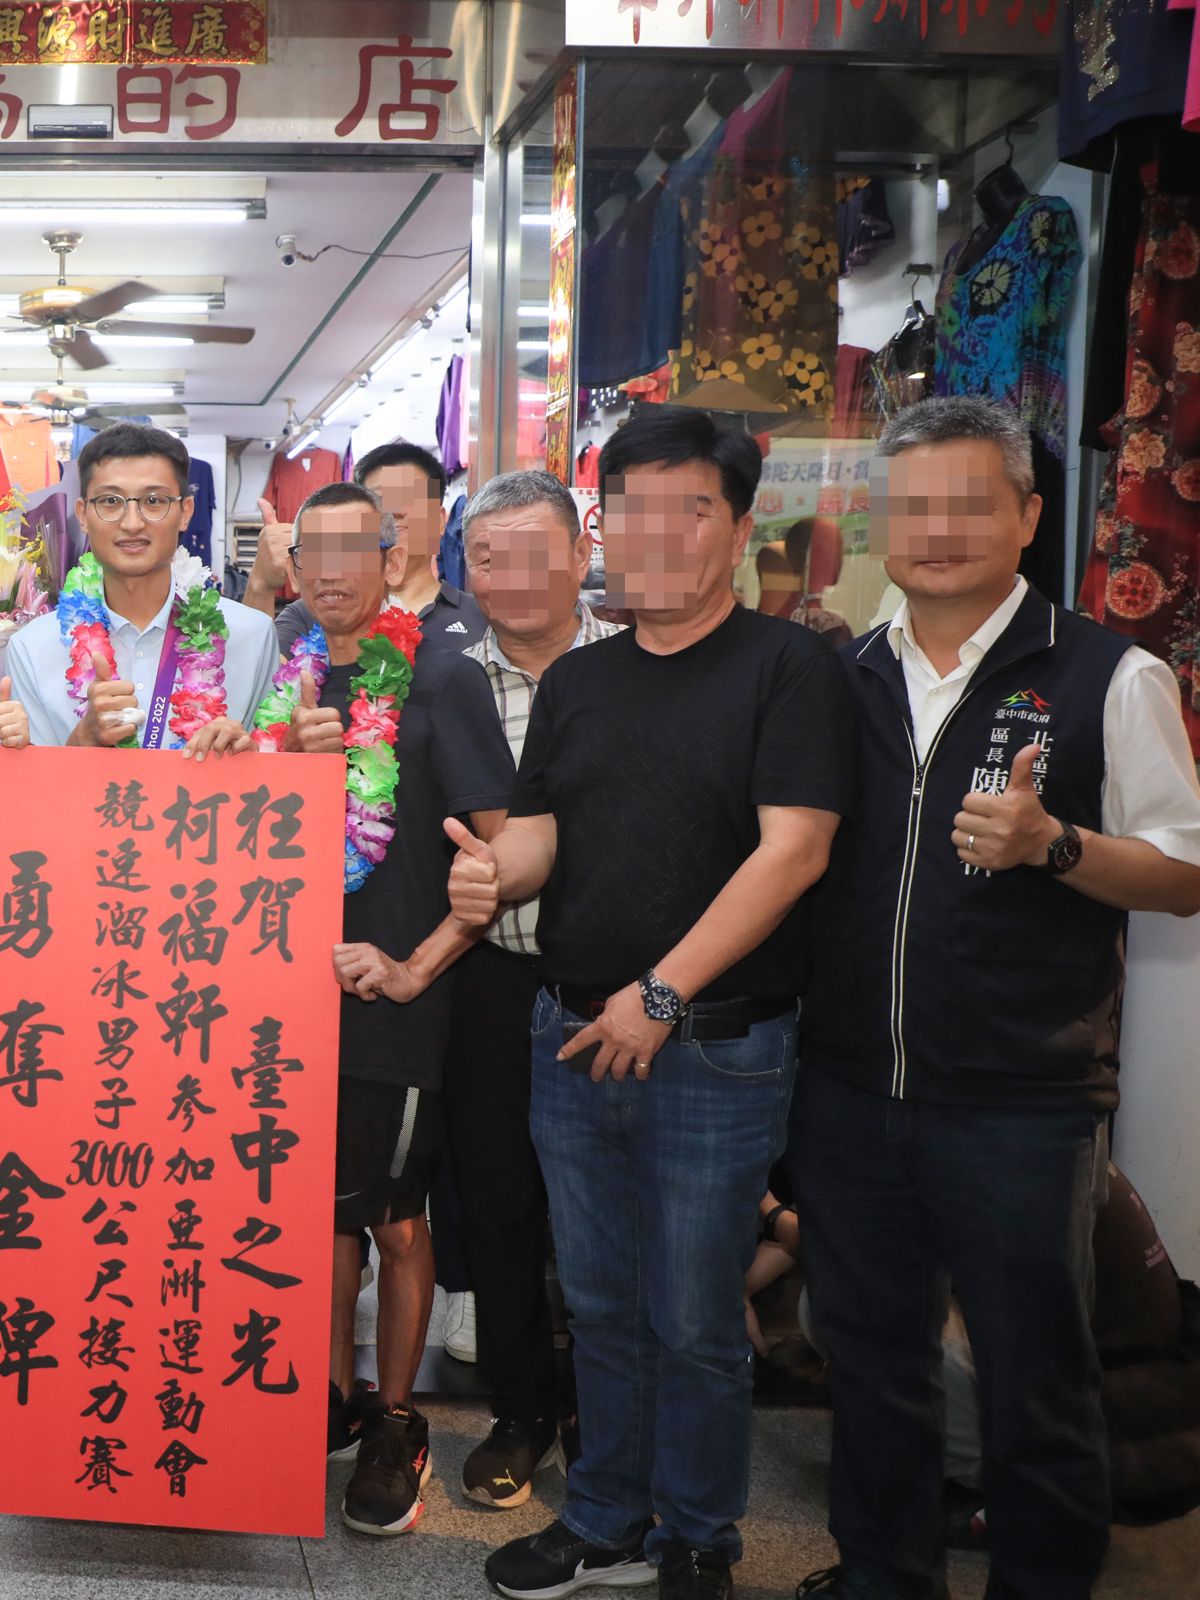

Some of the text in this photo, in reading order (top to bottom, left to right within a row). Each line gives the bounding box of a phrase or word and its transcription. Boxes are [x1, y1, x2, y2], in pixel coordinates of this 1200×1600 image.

[152, 696, 166, 723] 2022
[994, 707, 1050, 724] 臺中市政府
[220, 1015, 305, 1395] 臺中之光
